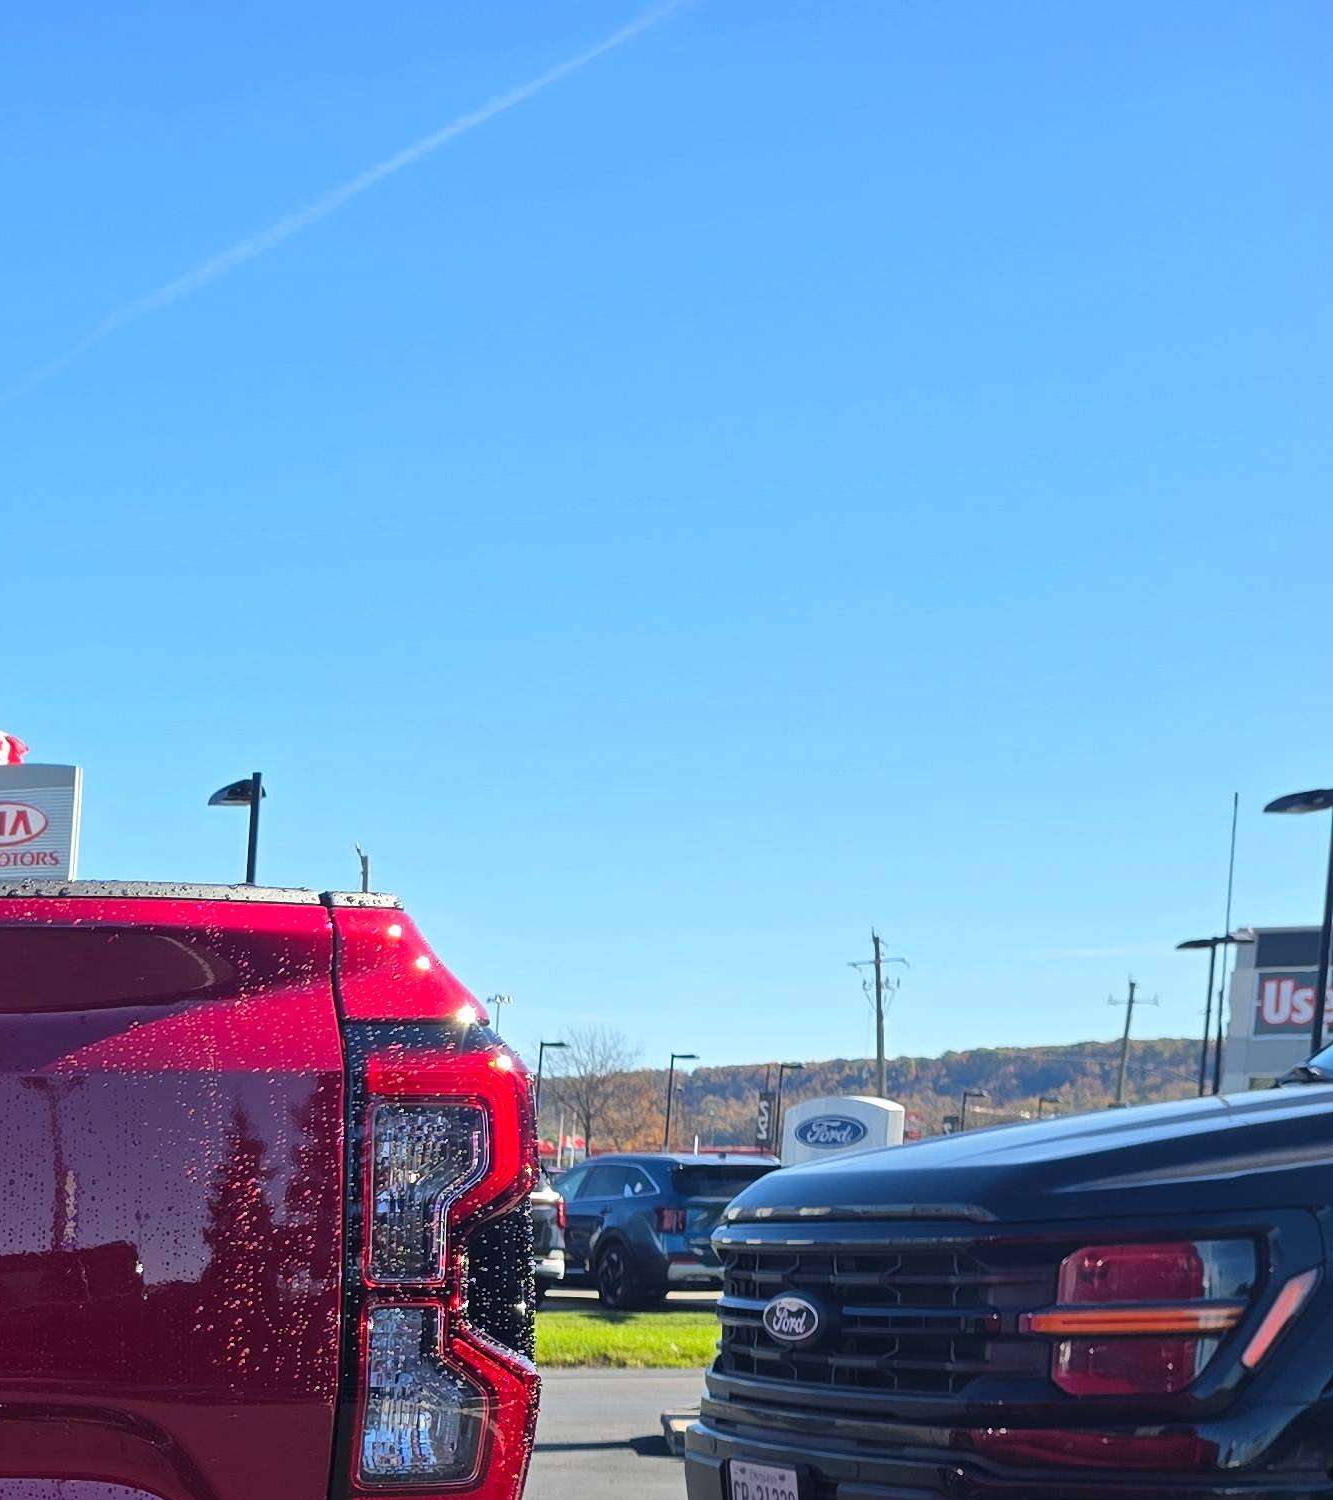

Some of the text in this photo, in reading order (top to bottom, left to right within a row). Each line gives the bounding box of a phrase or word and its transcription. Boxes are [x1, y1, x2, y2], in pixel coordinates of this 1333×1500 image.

[1263, 979, 1333, 1025] Us
[806, 1120, 854, 1144] Ford
[773, 1301, 807, 1334] Ford
